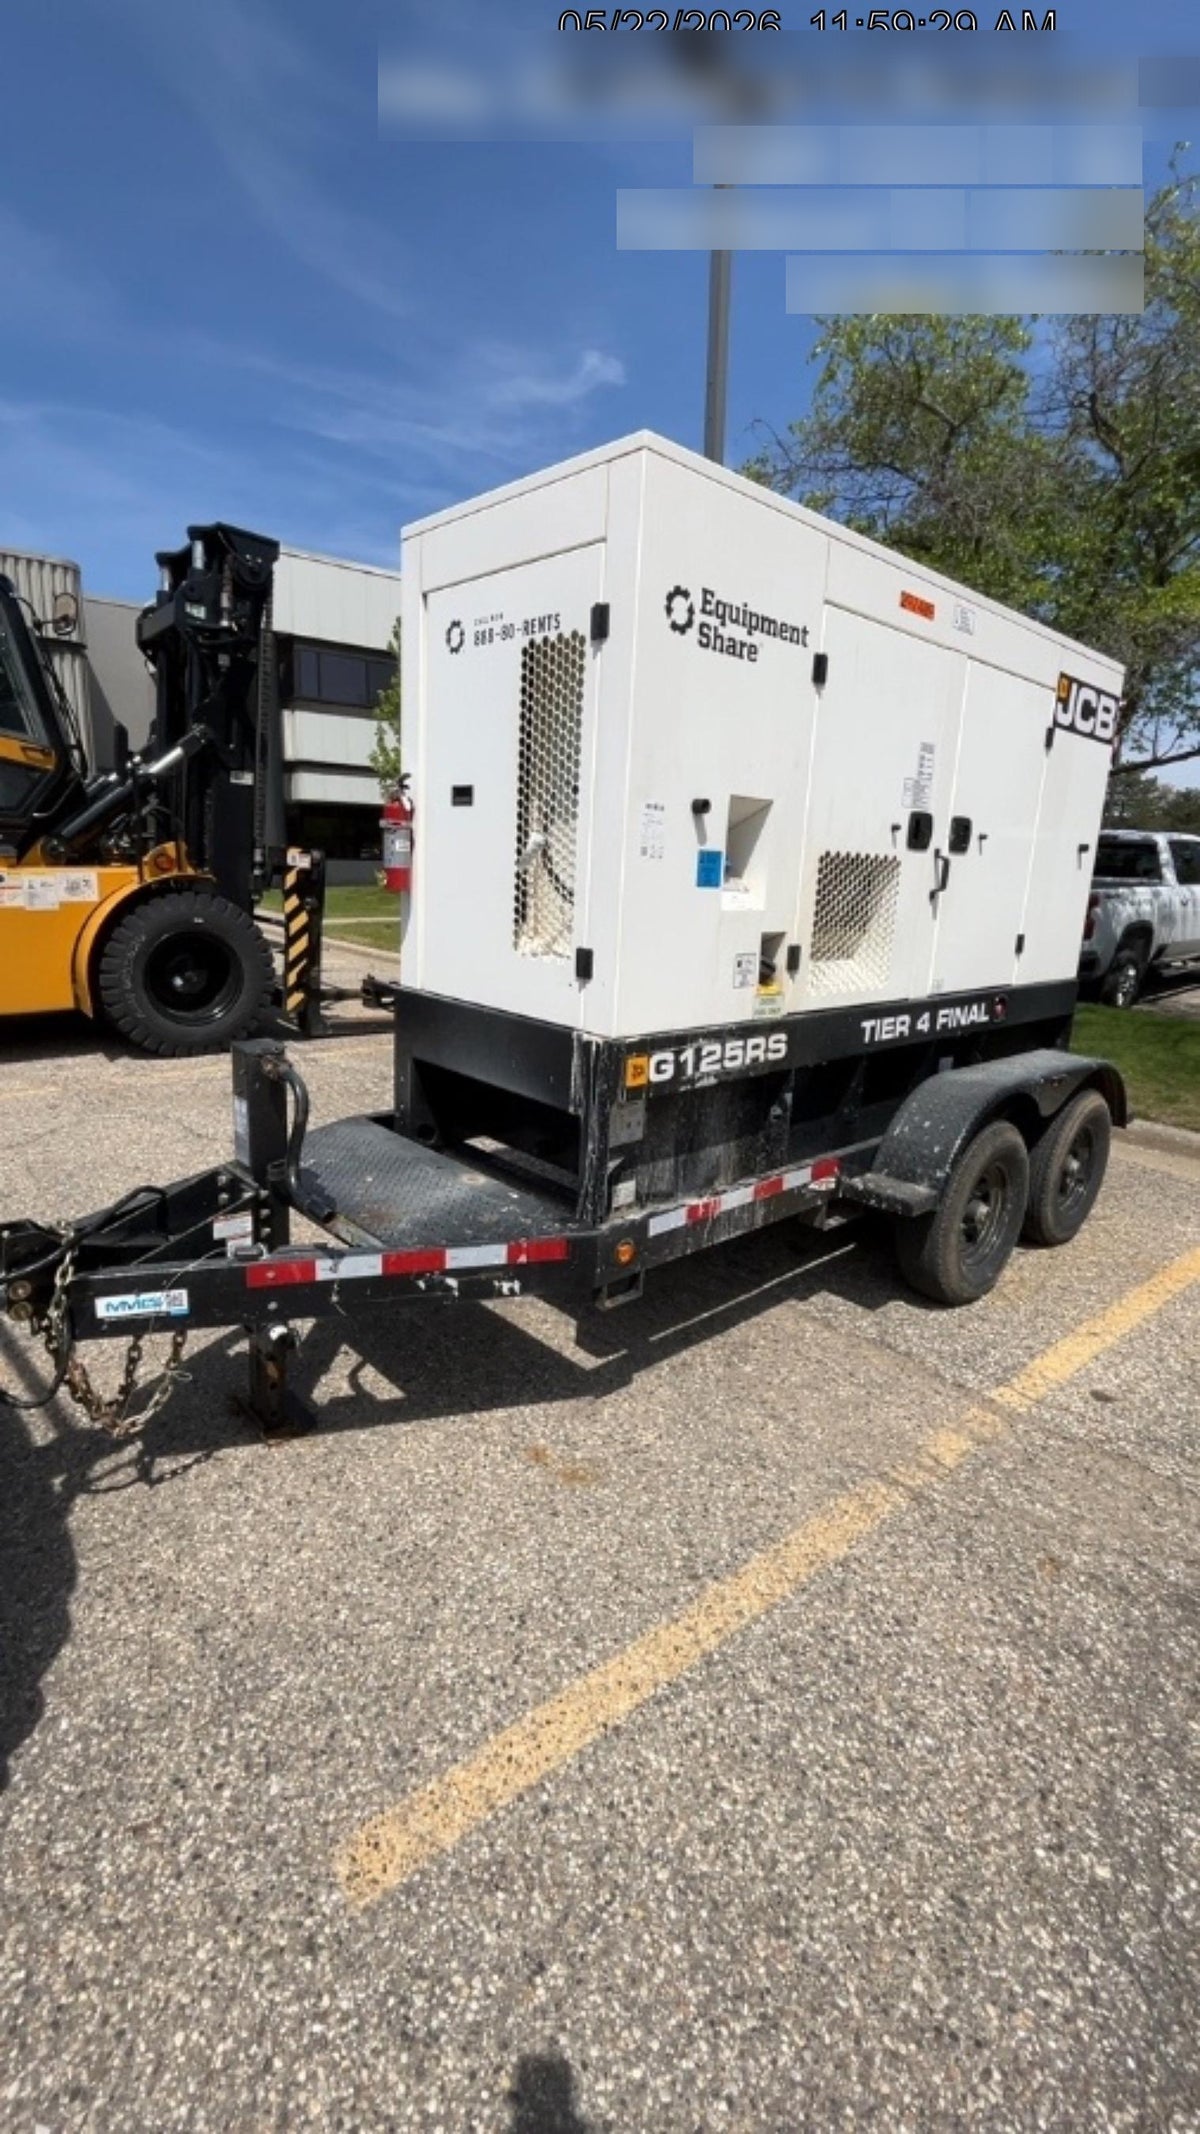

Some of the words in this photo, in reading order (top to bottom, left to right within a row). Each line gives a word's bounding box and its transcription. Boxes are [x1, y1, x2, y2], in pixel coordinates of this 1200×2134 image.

[697, 621, 760, 662] Share
[700, 587, 809, 648] Equipment
[1057, 682, 1117, 741] JCB
[860, 1014, 911, 1044] TIER
[916, 1011, 931, 1033] 4
[936, 1002, 990, 1031] FINAL
[649, 1033, 788, 1083] G125RS
